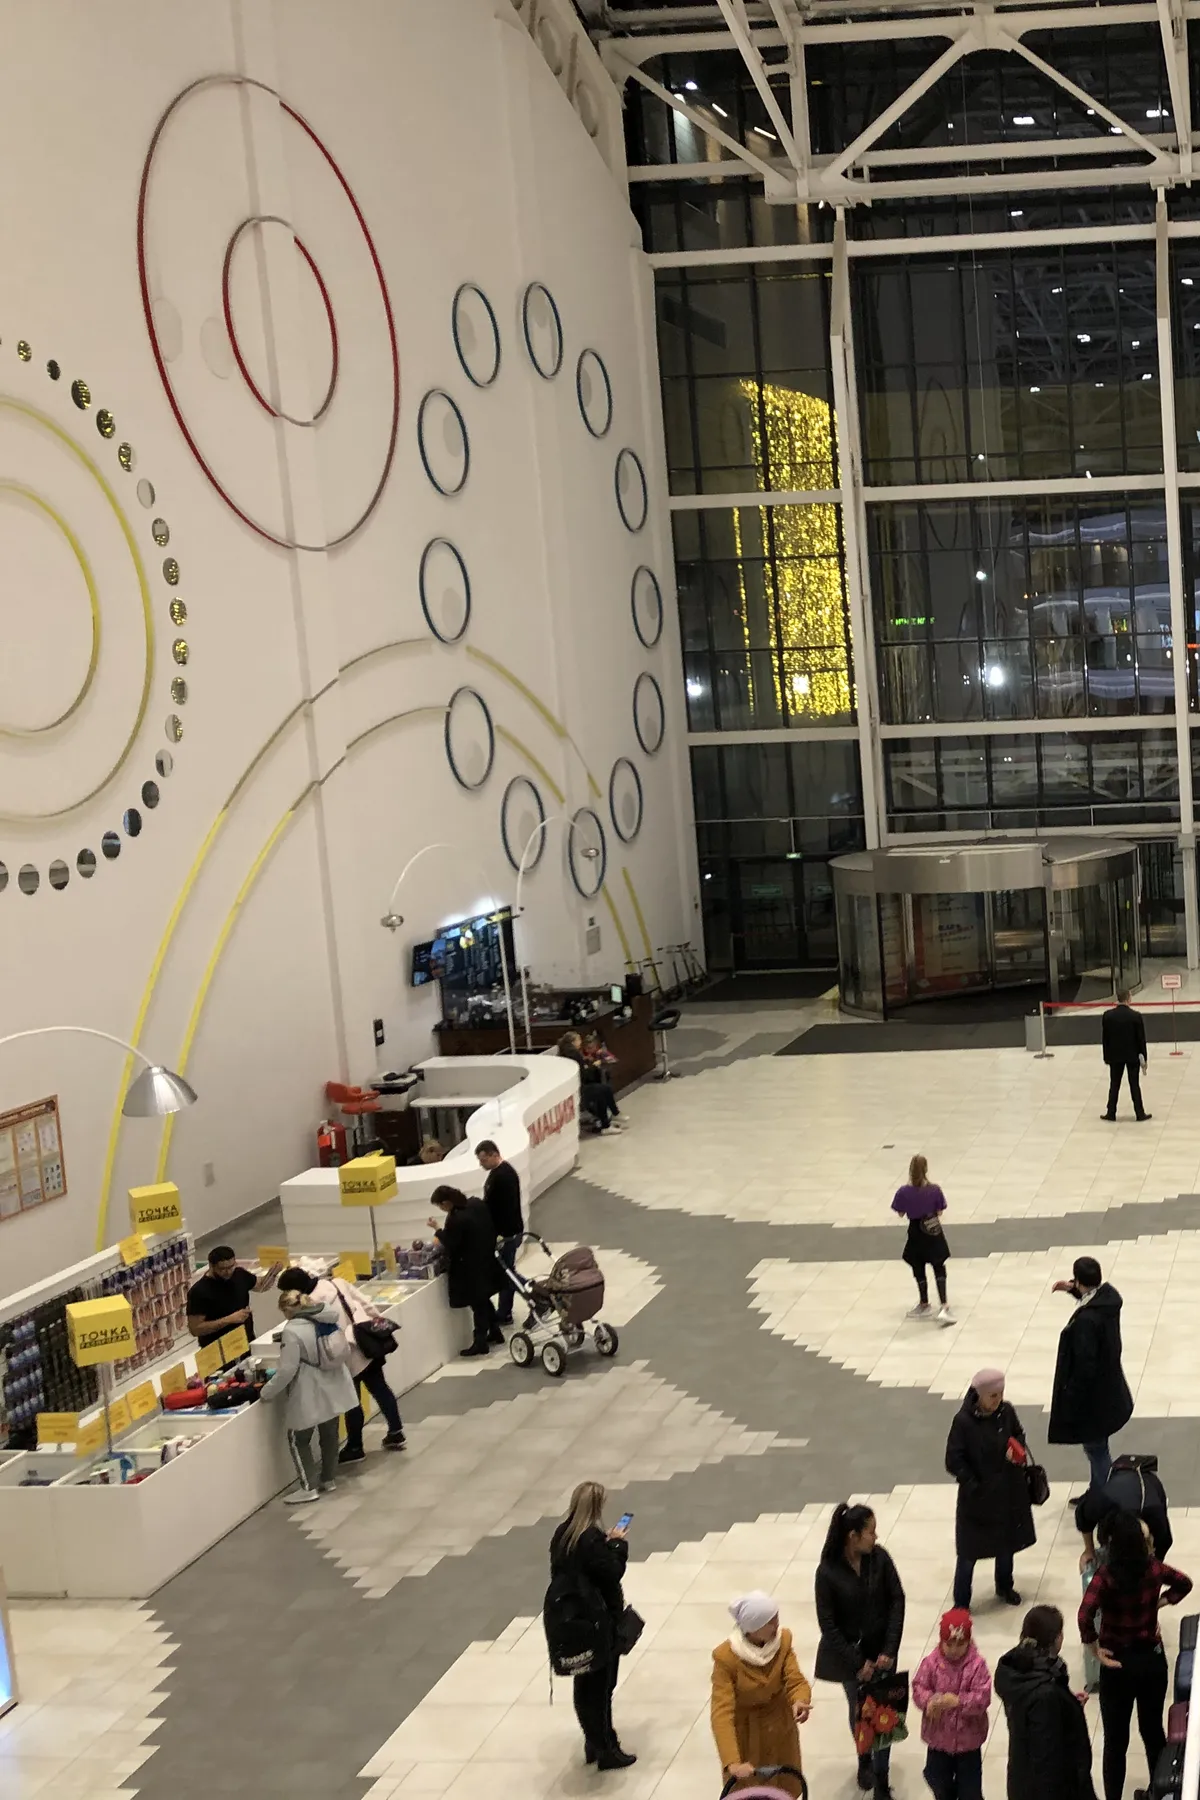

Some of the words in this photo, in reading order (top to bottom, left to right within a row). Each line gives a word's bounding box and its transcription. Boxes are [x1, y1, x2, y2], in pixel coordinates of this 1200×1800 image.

[342, 1180, 376, 1189] ТОЧКА
[139, 1204, 177, 1219] ТОЧКА
[80, 1325, 129, 1342] ТОЧКА
